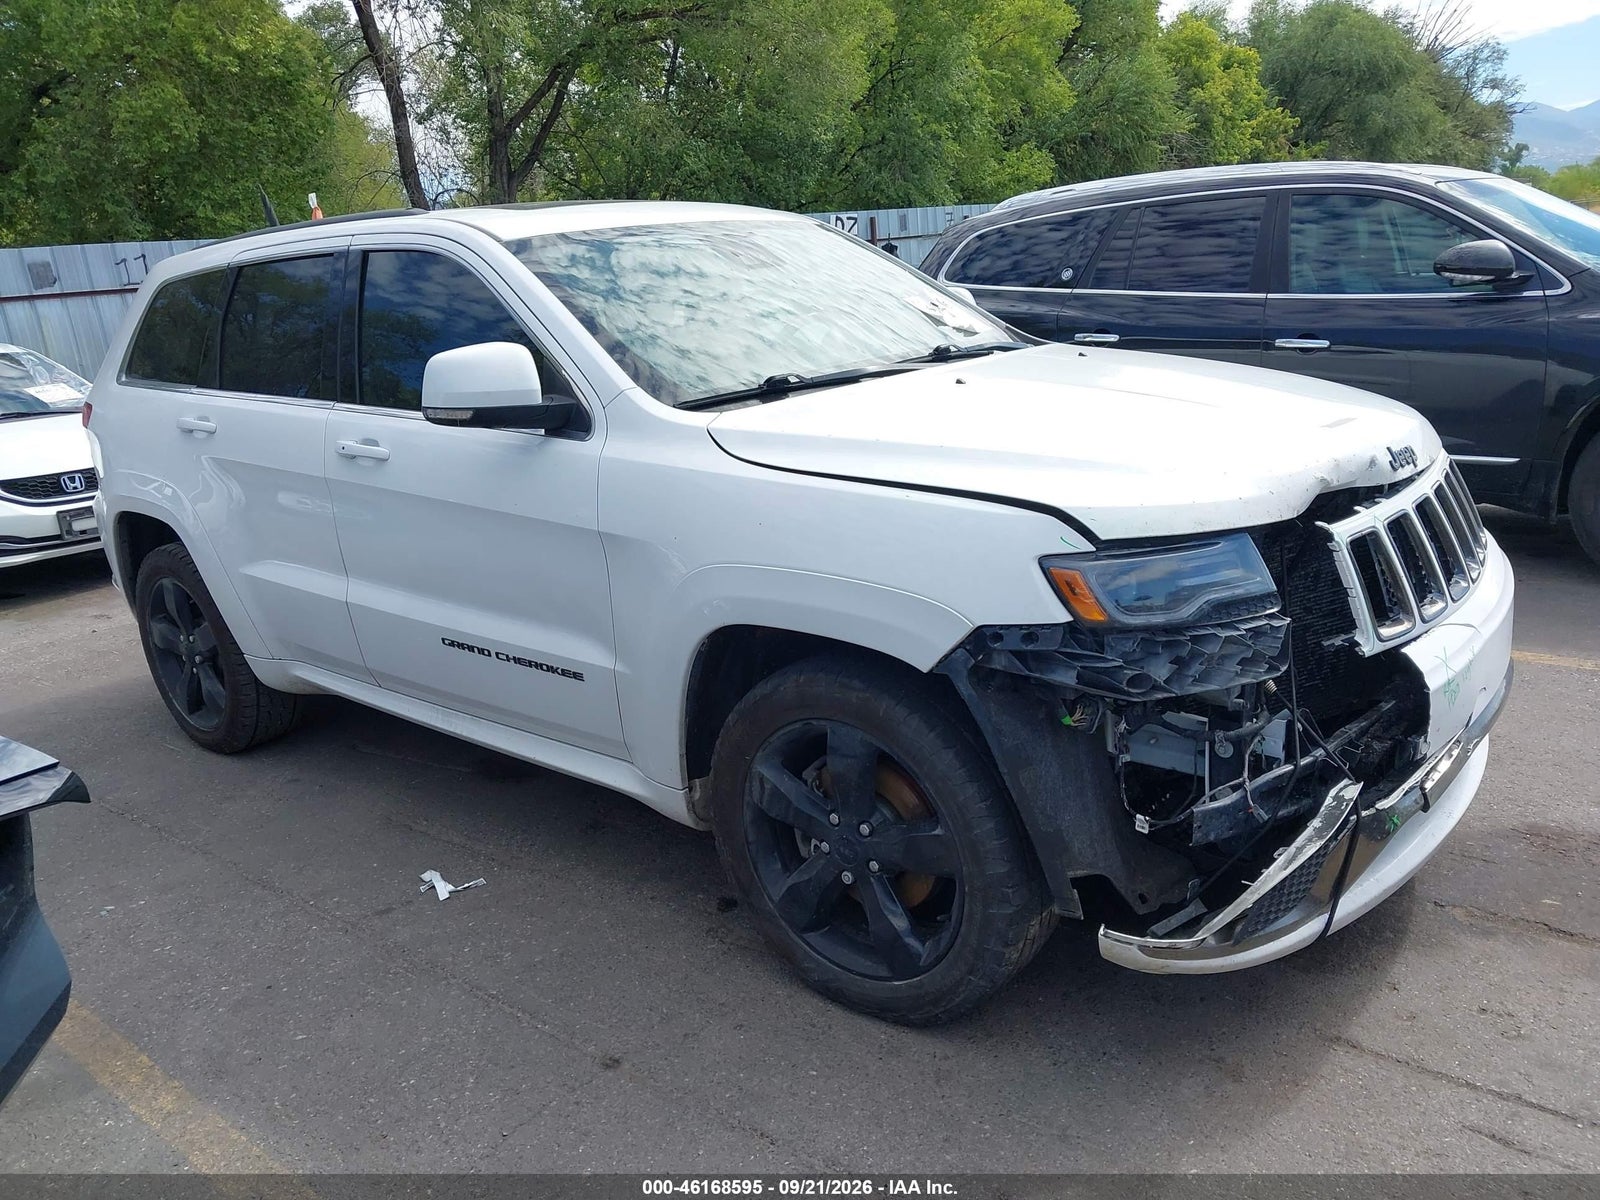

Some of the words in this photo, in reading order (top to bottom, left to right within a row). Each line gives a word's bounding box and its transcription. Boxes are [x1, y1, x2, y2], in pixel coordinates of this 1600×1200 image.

[1386, 445, 1418, 471] Jeep
[440, 637, 492, 657] GRAND
[495, 651, 585, 682] CHEROKEE
